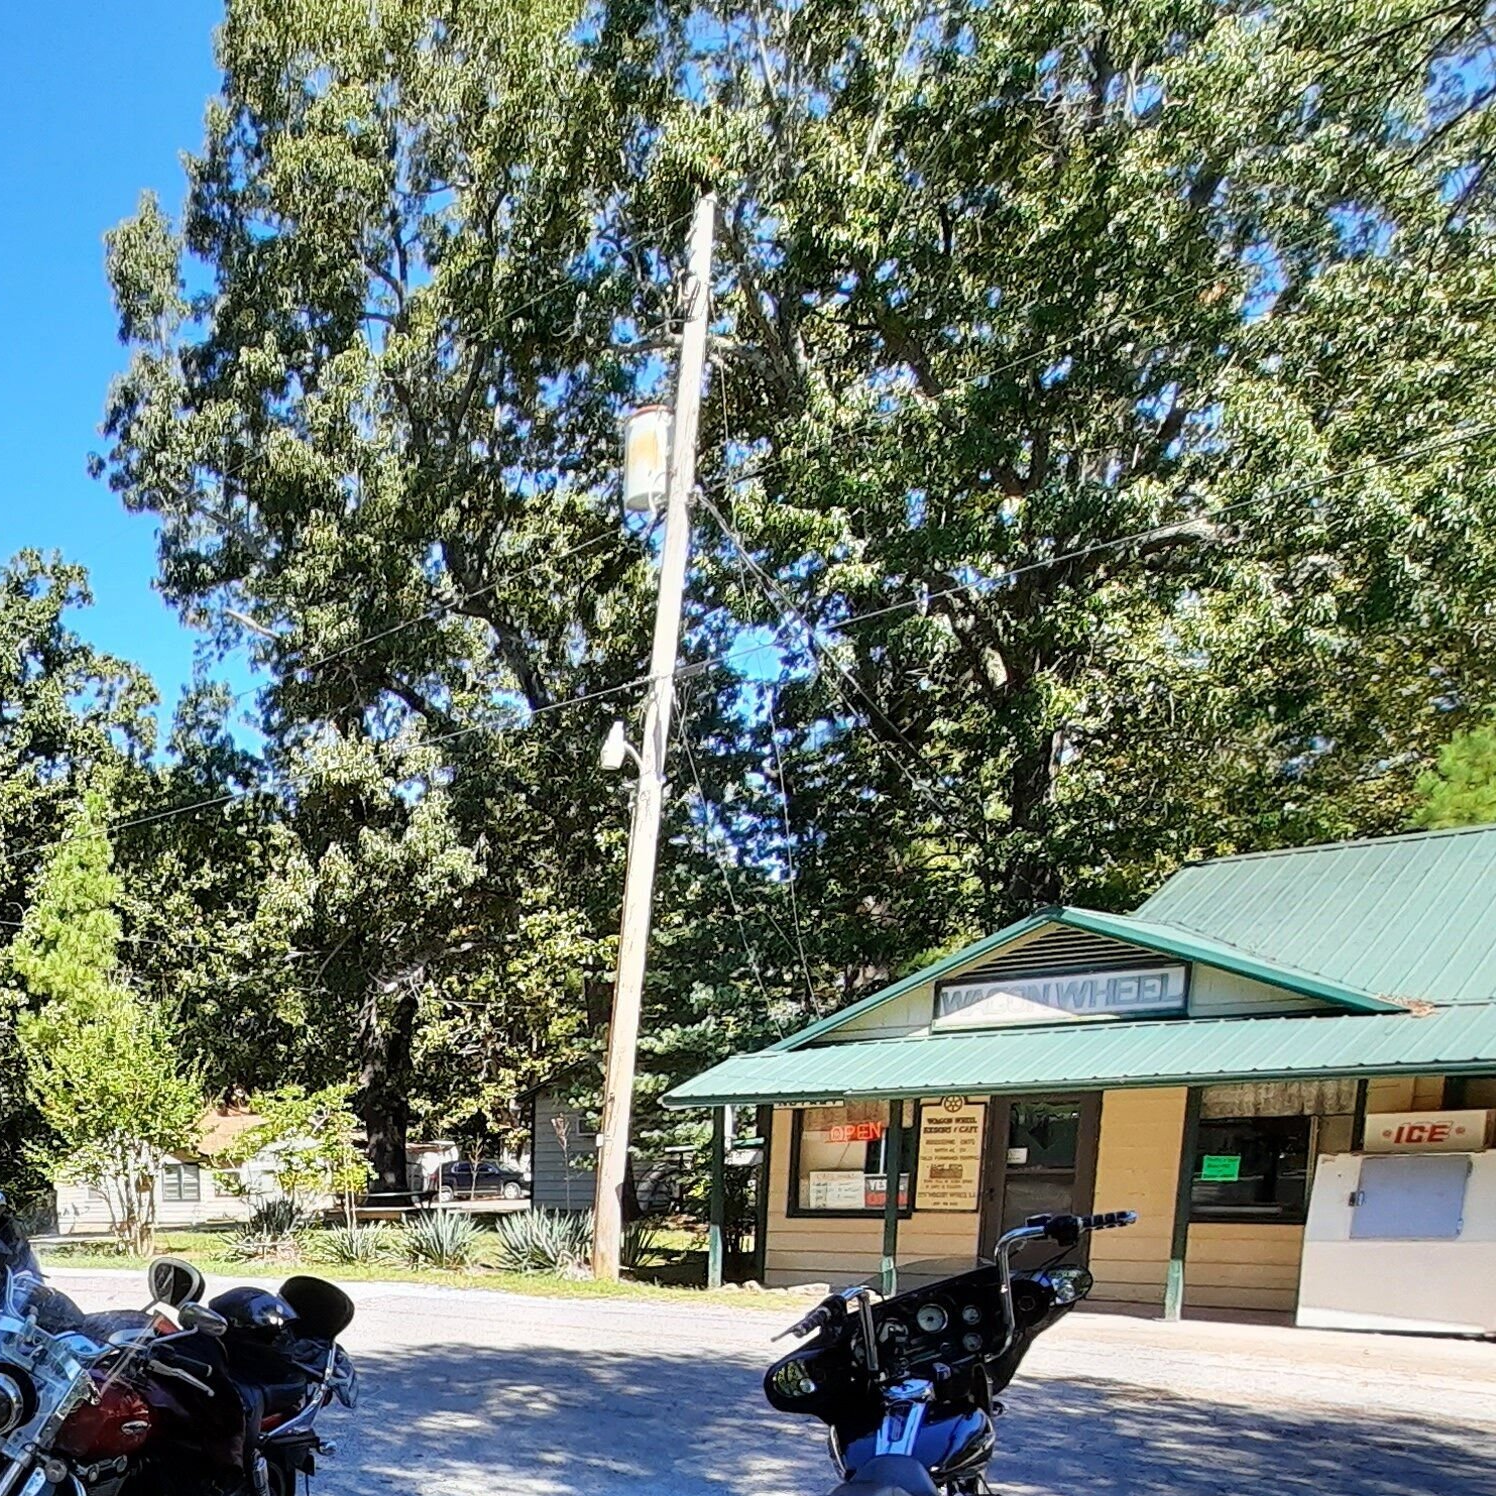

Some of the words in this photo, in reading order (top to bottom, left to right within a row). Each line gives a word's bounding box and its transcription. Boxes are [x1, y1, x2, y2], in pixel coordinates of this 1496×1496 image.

[940, 983, 1053, 1017] WAGON
[1055, 973, 1184, 1009] WHEEL
[830, 1121, 882, 1141] OPEN
[1394, 1121, 1452, 1144] ICE
